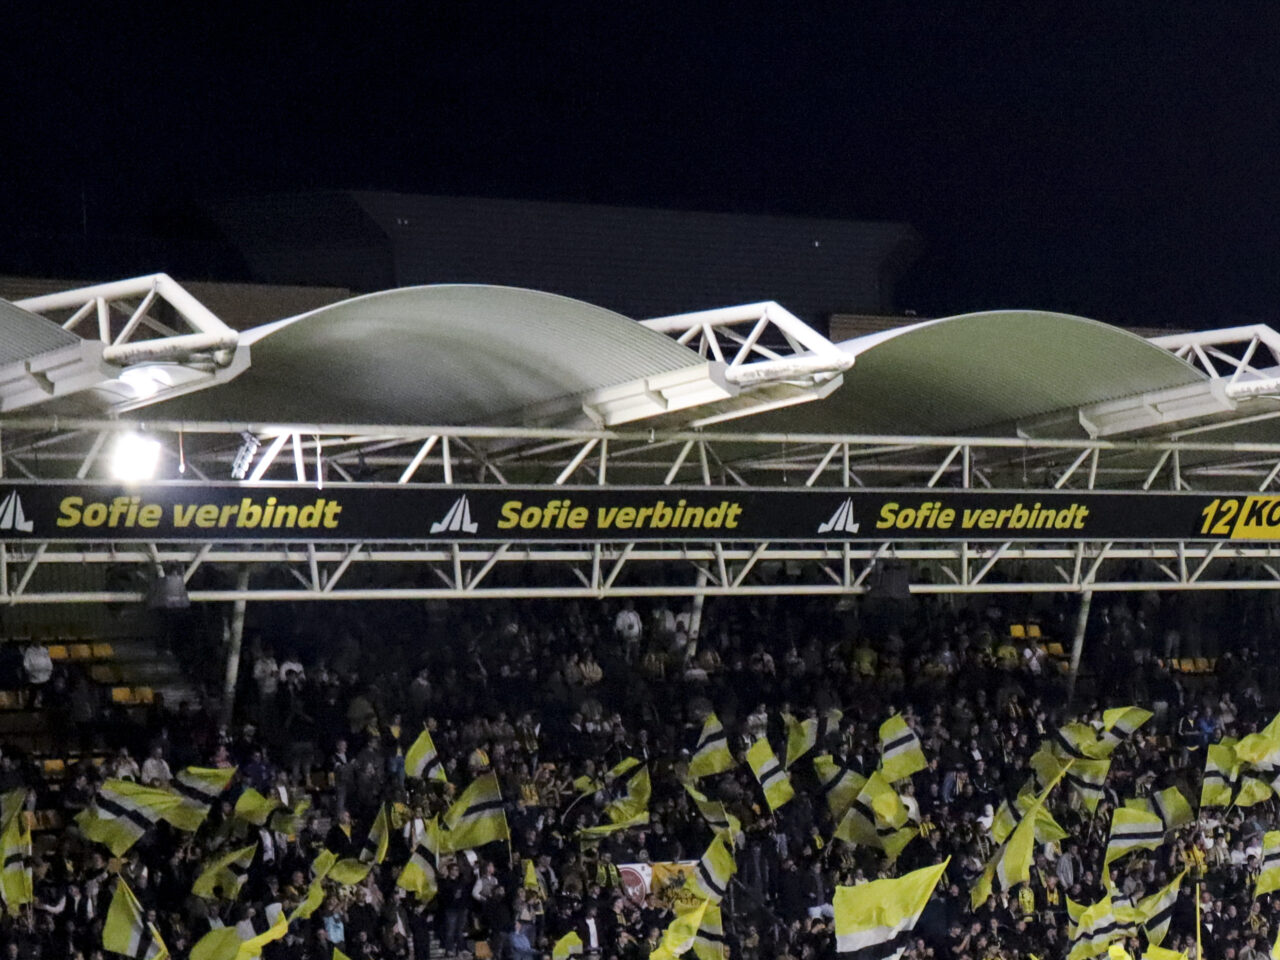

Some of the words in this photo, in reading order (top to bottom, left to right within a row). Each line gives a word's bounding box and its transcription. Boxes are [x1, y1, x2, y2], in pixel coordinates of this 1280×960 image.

[56, 496, 167, 529] Sofie
[172, 496, 343, 529] verbindt
[496, 498, 590, 530] Sofie
[596, 497, 741, 530] verbindt
[875, 501, 958, 531] Sofie
[961, 502, 1089, 531] verbindt
[1200, 499, 1239, 534] 12
